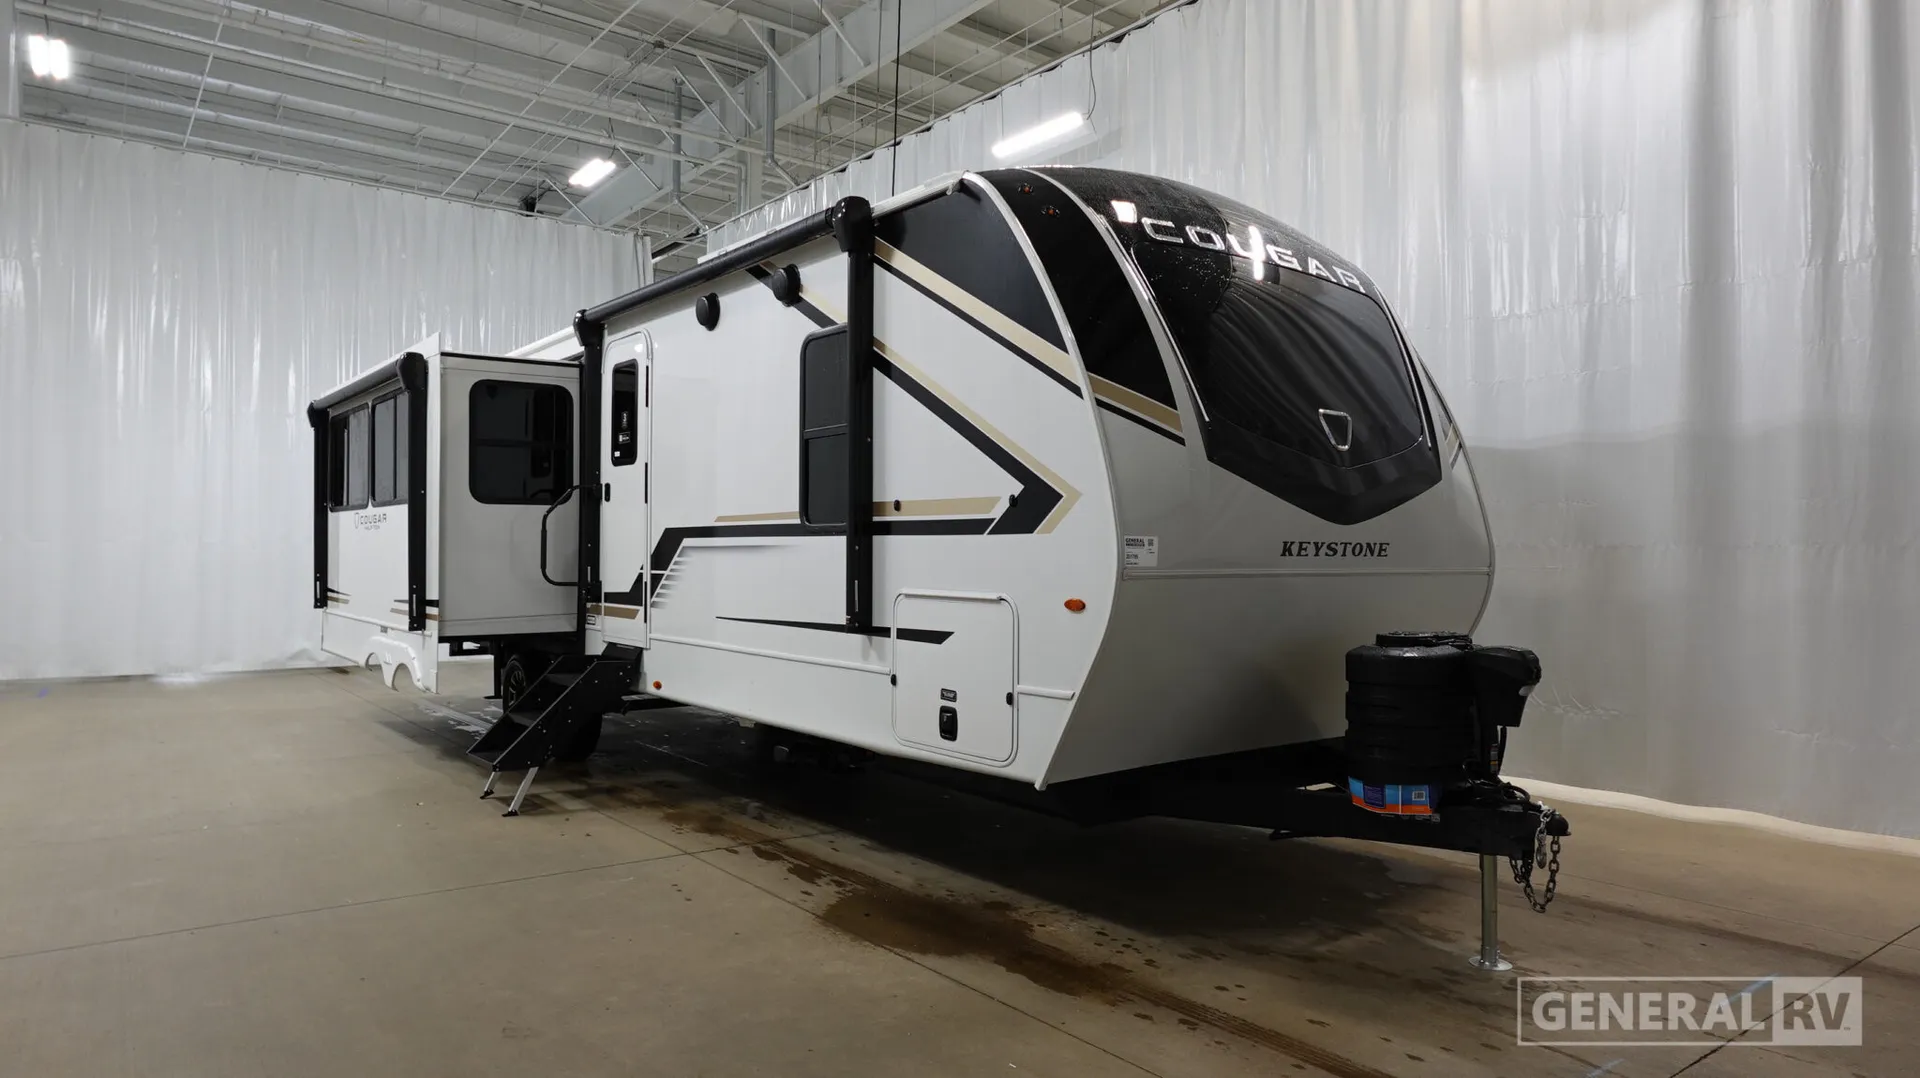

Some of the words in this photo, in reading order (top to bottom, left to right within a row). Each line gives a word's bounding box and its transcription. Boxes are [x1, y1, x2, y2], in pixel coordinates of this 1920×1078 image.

[1141, 217, 1366, 293] COUGAR
[360, 513, 387, 525] COUGAR
[1280, 541, 1390, 557] KEYSTONE
